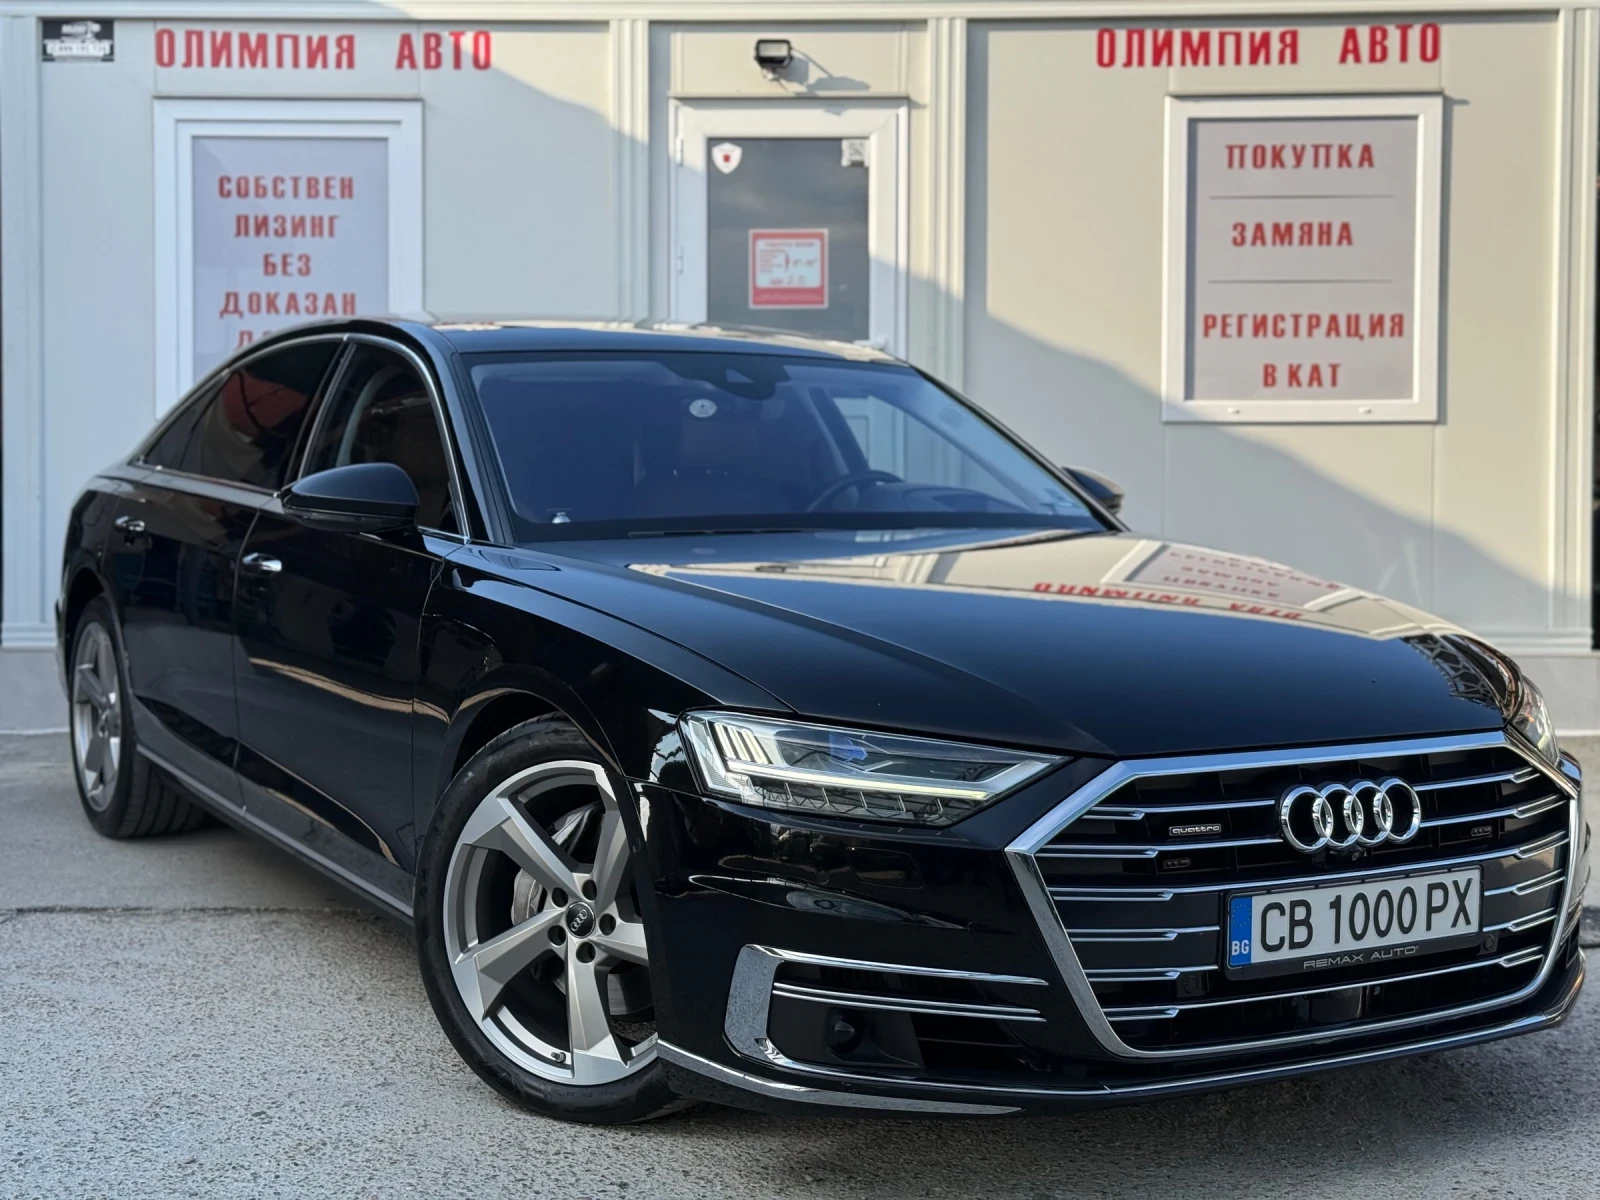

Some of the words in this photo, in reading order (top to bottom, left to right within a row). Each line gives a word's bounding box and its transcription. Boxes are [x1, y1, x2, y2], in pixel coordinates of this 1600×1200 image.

[155, 28, 356, 69] ОЛИМПИЯ
[395, 30, 493, 70] АВТО
[1096, 28, 1300, 68] ОЛИМПИЯ
[1338, 23, 1441, 64] АВТО
[1225, 143, 1375, 170] ПОКУПКА
[217, 175, 354, 200] СОБСТВЕН
[234, 213, 339, 239] ЛИЗИНГ
[1231, 221, 1354, 247] ЗАМЯНА
[262, 252, 312, 278] БЕЗ
[218, 291, 357, 318] ДОКАЗАН
[1202, 313, 1405, 341] РЕГИСТРАЦИЯ
[1262, 363, 1277, 388] В
[1287, 363, 1342, 388] КАТ
[1172, 825, 1220, 835] quattro
[1260, 899, 1313, 953] CB
[1329, 886, 1418, 945] 1000
[1425, 877, 1474, 932] PX
[1231, 940, 1250, 956] BG
[1303, 953, 1364, 970] REMAX
